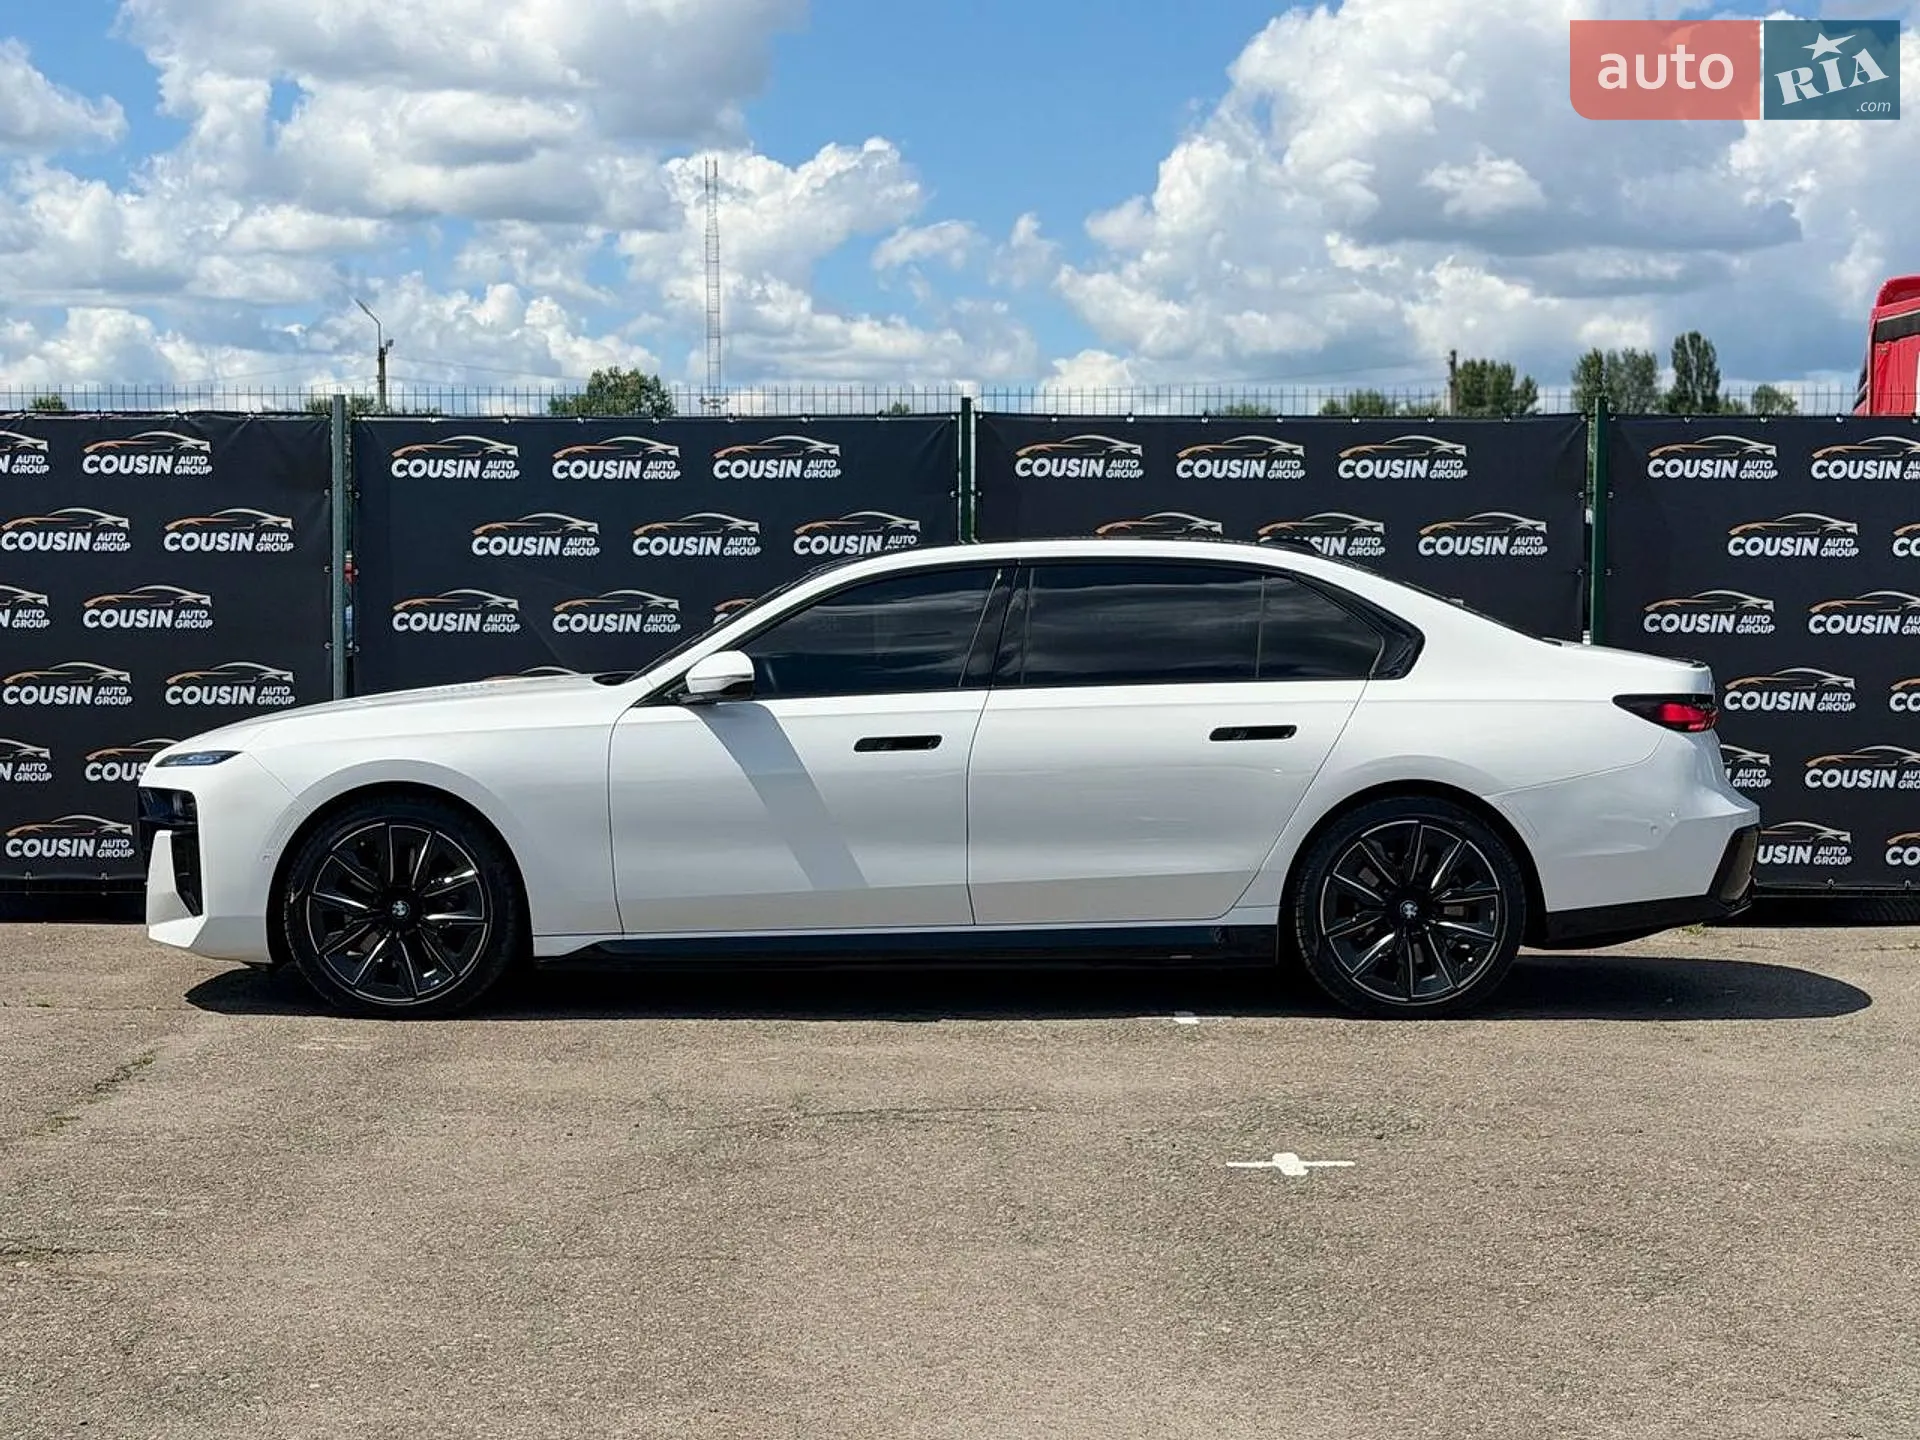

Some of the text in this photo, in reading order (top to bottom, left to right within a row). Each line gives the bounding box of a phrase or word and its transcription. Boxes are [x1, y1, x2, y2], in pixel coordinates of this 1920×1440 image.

[15, 454, 45, 463] AUTO
[178, 455, 208, 464] AUTO
[486, 459, 516, 468] AUTO
[807, 459, 837, 468] AUTO
[1109, 459, 1139, 468] AUTO
[1271, 459, 1301, 468] AUTO
[1433, 459, 1463, 468] AUTO
[1744, 459, 1774, 468] AUTO
[11, 464, 49, 474] GROUP
[82, 455, 173, 474] COUSIN
[390, 459, 481, 478] COUSIN
[551, 460, 642, 479] COUSIN
[646, 460, 676, 469] AUTO
[712, 459, 803, 478] COUSIN
[1014, 458, 1105, 477] COUSIN
[1175, 459, 1266, 478] COUSIN
[1337, 459, 1428, 478] COUSIN
[1647, 459, 1738, 478] COUSIN
[1810, 460, 1901, 479] COUSIN
[174, 465, 212, 475] GROUP
[482, 469, 520, 479] GROUP
[642, 470, 680, 480] GROUP
[803, 469, 841, 479] GROUP
[1105, 469, 1143, 479] GROUP
[1267, 469, 1305, 479] GROUP
[1429, 469, 1467, 479] GROUP
[1740, 469, 1778, 479] GROUP
[1, 532, 92, 551] COUSIN
[96, 532, 126, 541] AUTO
[163, 532, 254, 551] COUSIN
[259, 532, 289, 541] AUTO
[566, 536, 596, 545] AUTO
[727, 536, 757, 545] AUTO
[887, 535, 917, 545] AUTO
[1351, 536, 1381, 545] AUTO
[1513, 536, 1543, 545] AUTO
[1824, 537, 1854, 546] AUTO
[92, 542, 130, 552] GROUP
[255, 542, 293, 552] GROUP
[470, 537, 561, 556] COUSIN
[631, 537, 722, 556] COUSIN
[792, 535, 883, 554] COUSIN
[1418, 536, 1509, 555] COUSIN
[1728, 537, 1819, 556] COUSIN
[562, 546, 600, 556] GROUP
[723, 546, 761, 556] GROUP
[1347, 546, 1385, 556] GROUP
[1509, 546, 1547, 556] GROUP
[1820, 547, 1858, 557] GROUP
[16, 608, 46, 617] AUTO
[178, 609, 208, 618] AUTO
[486, 613, 516, 622] AUTO
[647, 613, 677, 622] AUTO
[12, 618, 50, 628] GROUP
[82, 609, 173, 628] COUSIN
[391, 613, 482, 632] COUSIN
[551, 613, 642, 632] COUSIN
[1644, 614, 1735, 633] COUSIN
[1740, 614, 1770, 623] AUTO
[174, 619, 212, 629] GROUP
[482, 623, 520, 633] GROUP
[643, 623, 681, 633] GROUP
[1736, 624, 1774, 634] GROUP
[1807, 615, 1898, 634] COUSIN
[98, 686, 128, 695] AUTO
[261, 685, 291, 694] AUTO
[2, 686, 93, 705] COUSIN
[165, 686, 256, 705] COUSIN
[257, 695, 295, 705] GROUP
[1821, 692, 1851, 701] AUTO
[94, 696, 132, 706] GROUP
[1725, 692, 1816, 711] COUSIN
[1817, 702, 1855, 712] GROUP
[18, 762, 48, 771] AUTO
[14, 772, 52, 782] GROUP
[1737, 768, 1767, 777] AUTO
[1733, 778, 1771, 788] GROUP
[1804, 769, 1895, 788] COUSIN
[4, 838, 95, 857] COUSIN
[100, 838, 130, 847] AUTO
[96, 848, 134, 858] GROUP
[1757, 844, 1812, 864] USIN
[1817, 846, 1847, 855] AUTO
[1813, 856, 1851, 866] GROUP
